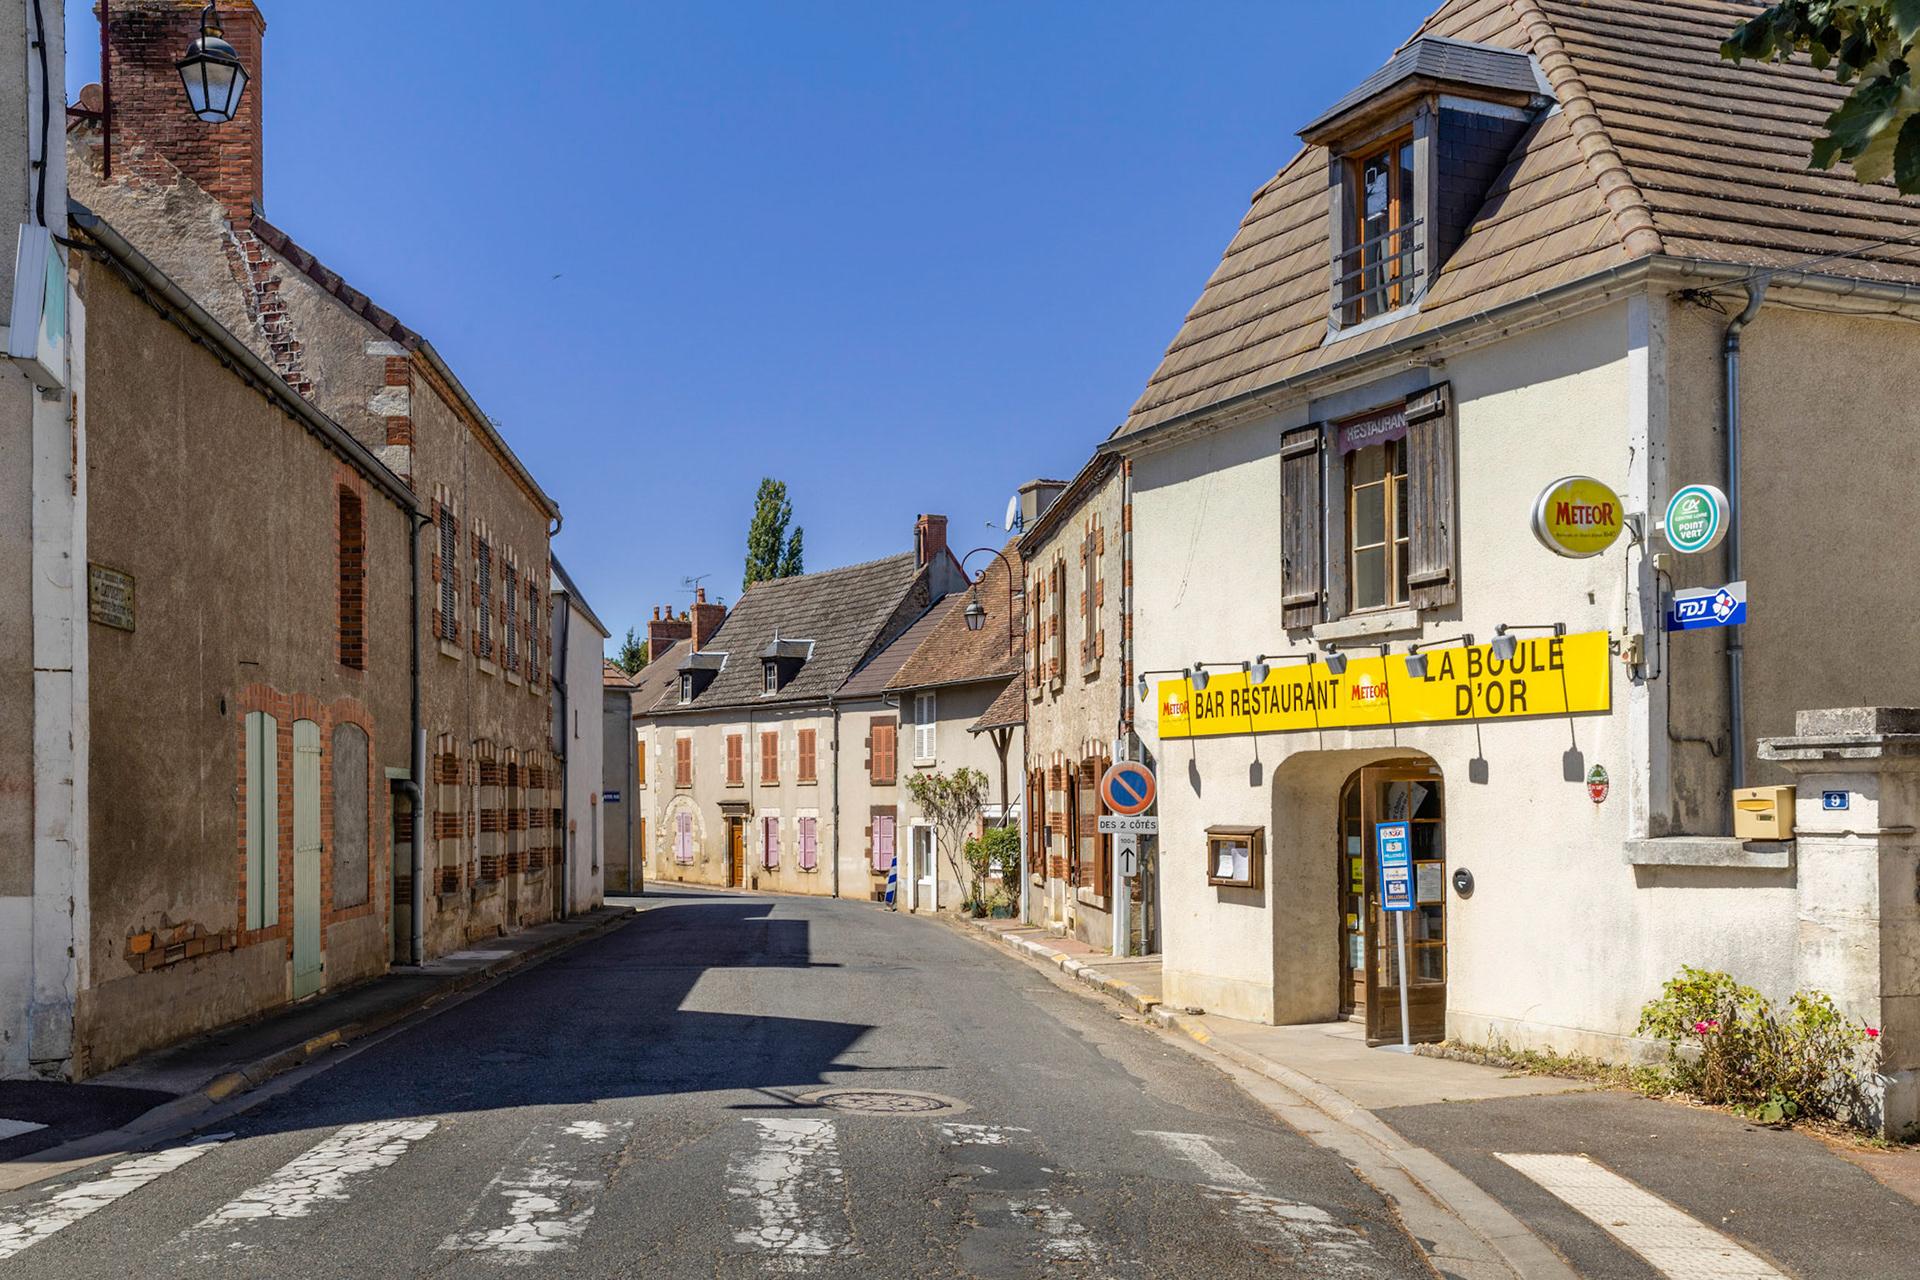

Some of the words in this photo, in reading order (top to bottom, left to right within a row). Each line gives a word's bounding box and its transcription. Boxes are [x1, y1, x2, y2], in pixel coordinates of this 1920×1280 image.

[1347, 412, 1406, 441] RESTAURAN
[1556, 501, 1615, 526] METEOR
[1678, 520, 1704, 531] POINT
[1678, 600, 1708, 618] FDJ
[1467, 638, 1564, 678] BOULE
[1195, 690, 1225, 720] BAR
[1231, 679, 1339, 717] RESTAURANT
[1351, 682, 1389, 701] METEOR
[1456, 679, 1527, 716] D'OR
[1162, 699, 1190, 716] METEOR
[1830, 794, 1840, 807] 9
[1100, 820, 1116, 829] DES
[1120, 821, 1126, 829] 2
[1129, 818, 1156, 829] CÔTÉS
[1391, 842, 1396, 850] 5
